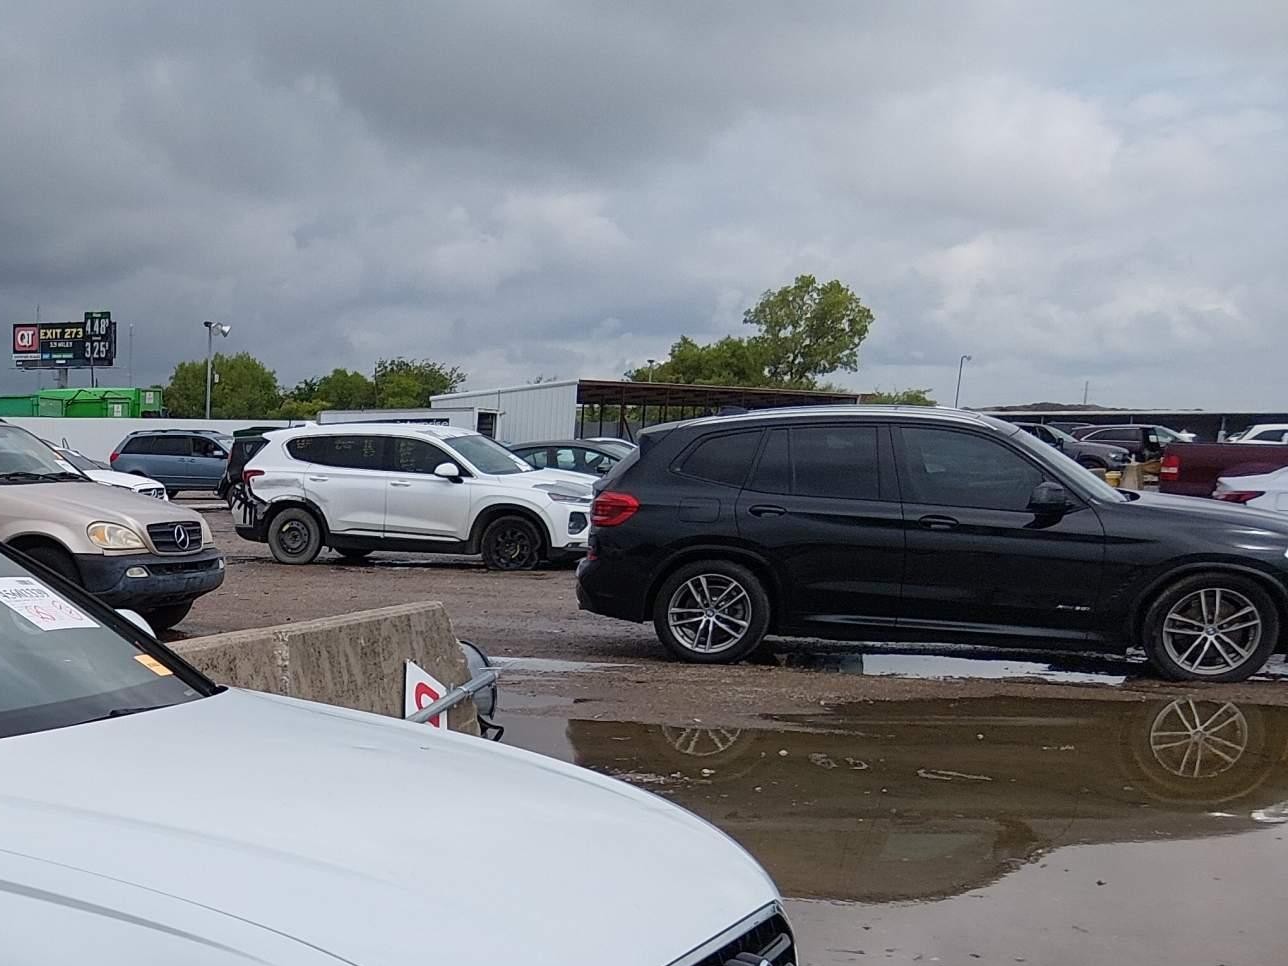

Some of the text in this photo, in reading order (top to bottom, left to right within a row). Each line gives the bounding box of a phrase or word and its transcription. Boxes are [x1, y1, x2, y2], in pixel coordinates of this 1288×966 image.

[17, 330, 34, 347] QT
[40, 329, 62, 339] EXIT
[64, 328, 83, 339] 273
